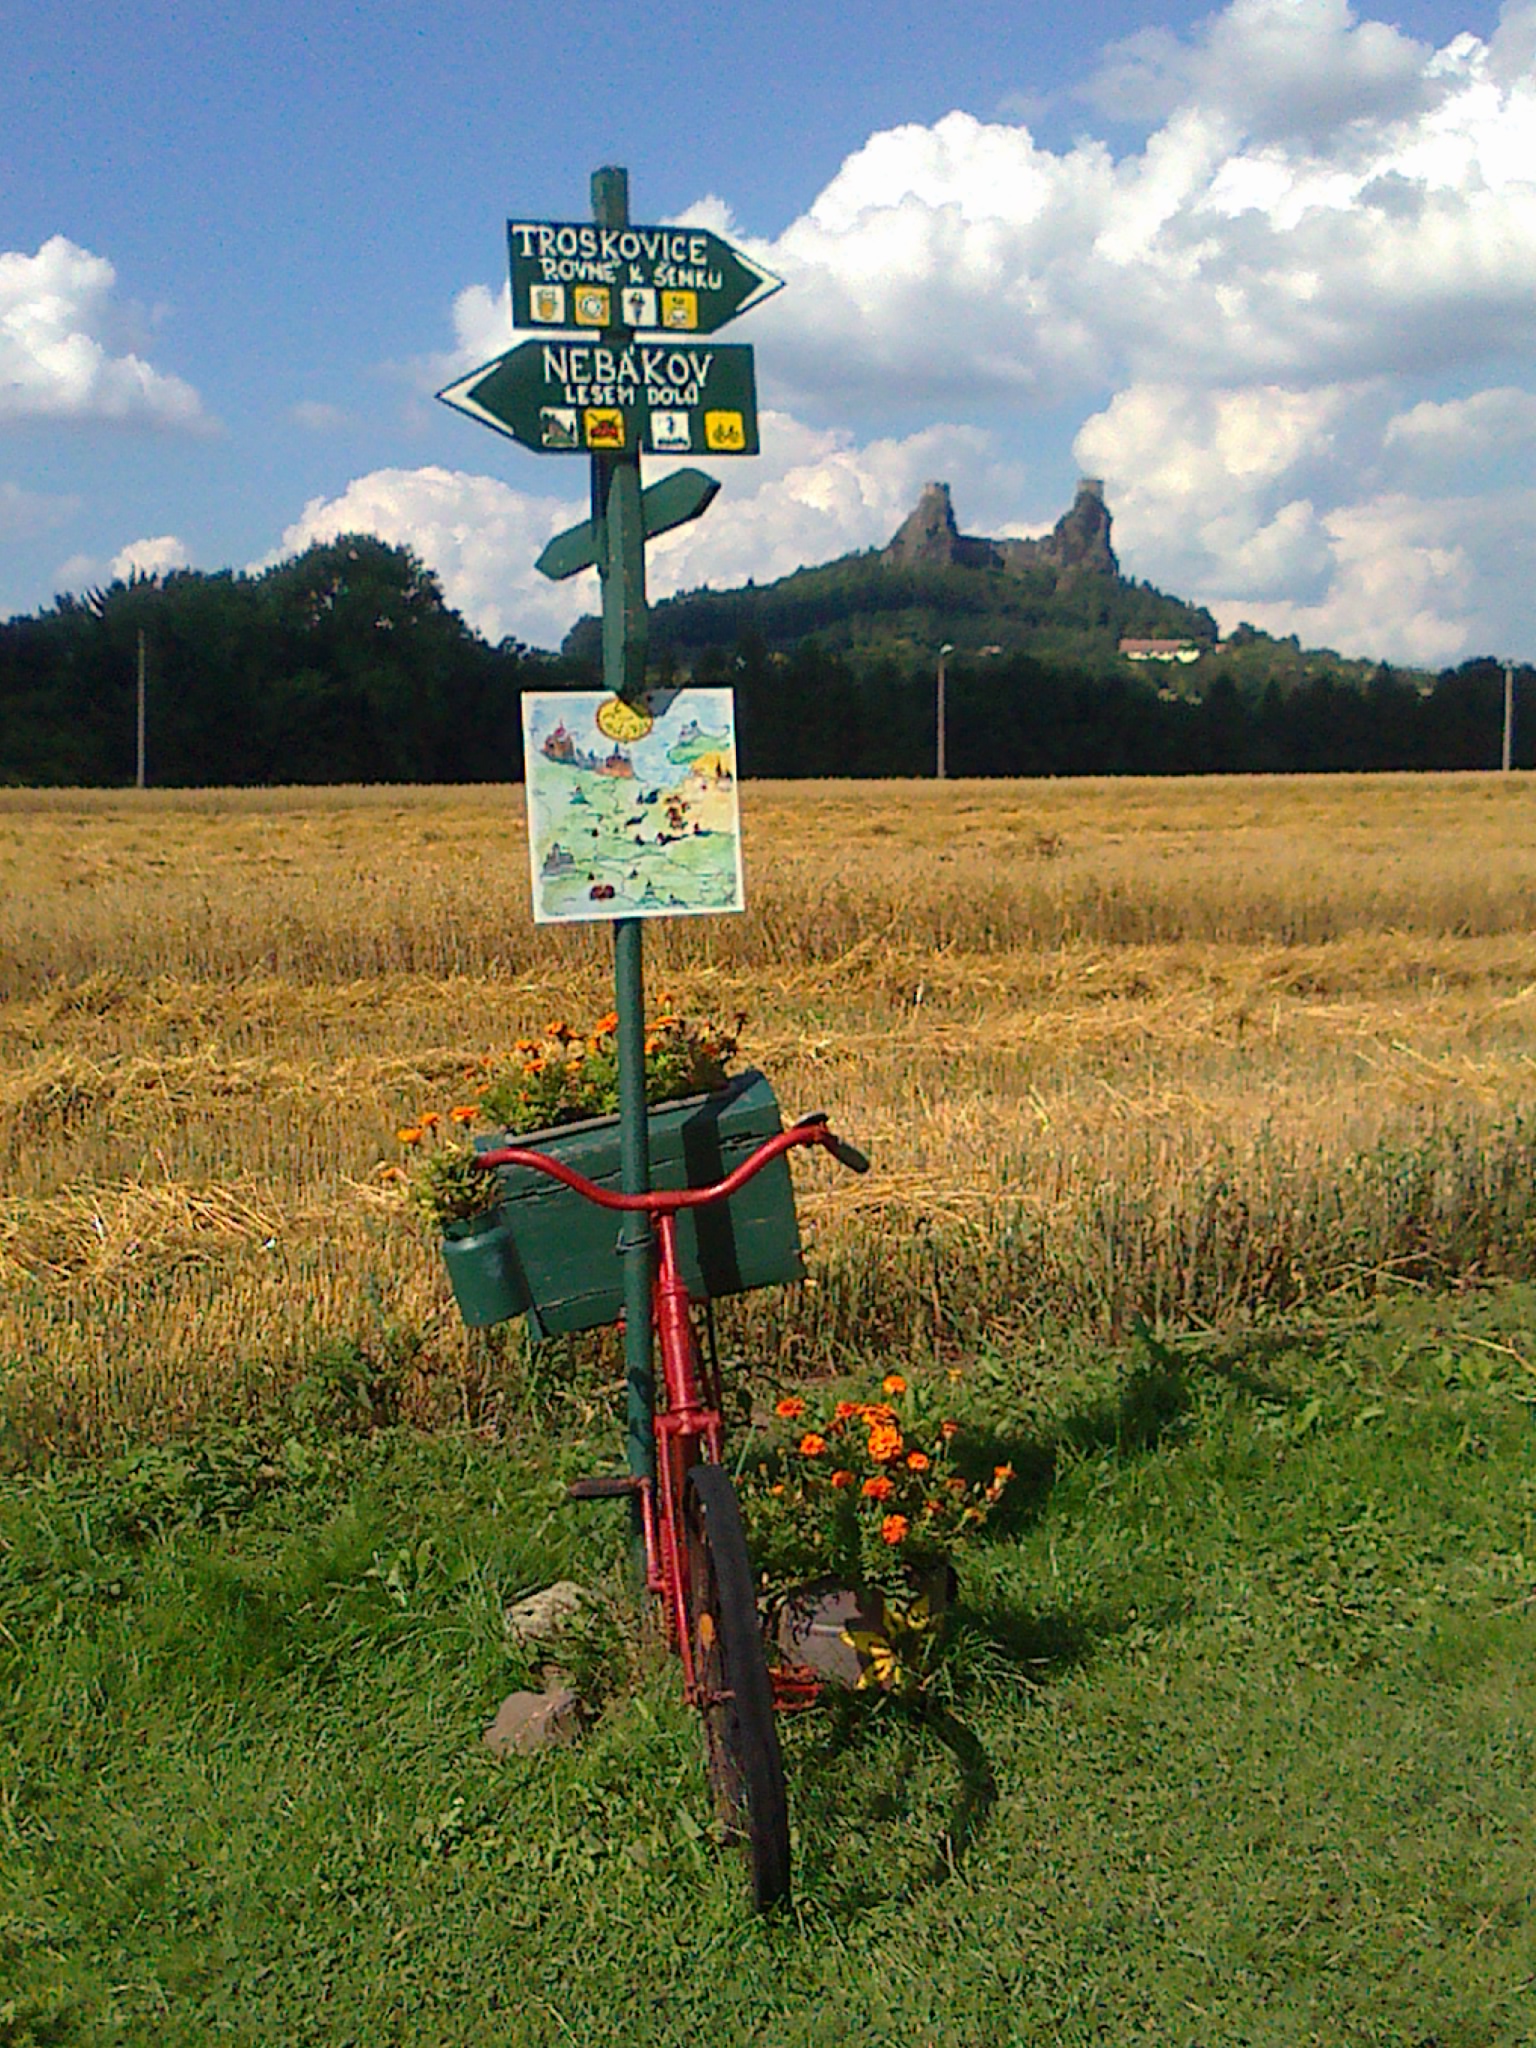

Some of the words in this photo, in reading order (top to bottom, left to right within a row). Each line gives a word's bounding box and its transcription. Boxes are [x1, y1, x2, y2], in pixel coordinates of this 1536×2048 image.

[512, 224, 708, 265] TROSKOVICE
[629, 263, 645, 285] K
[542, 344, 713, 388] NEBÁKOV
